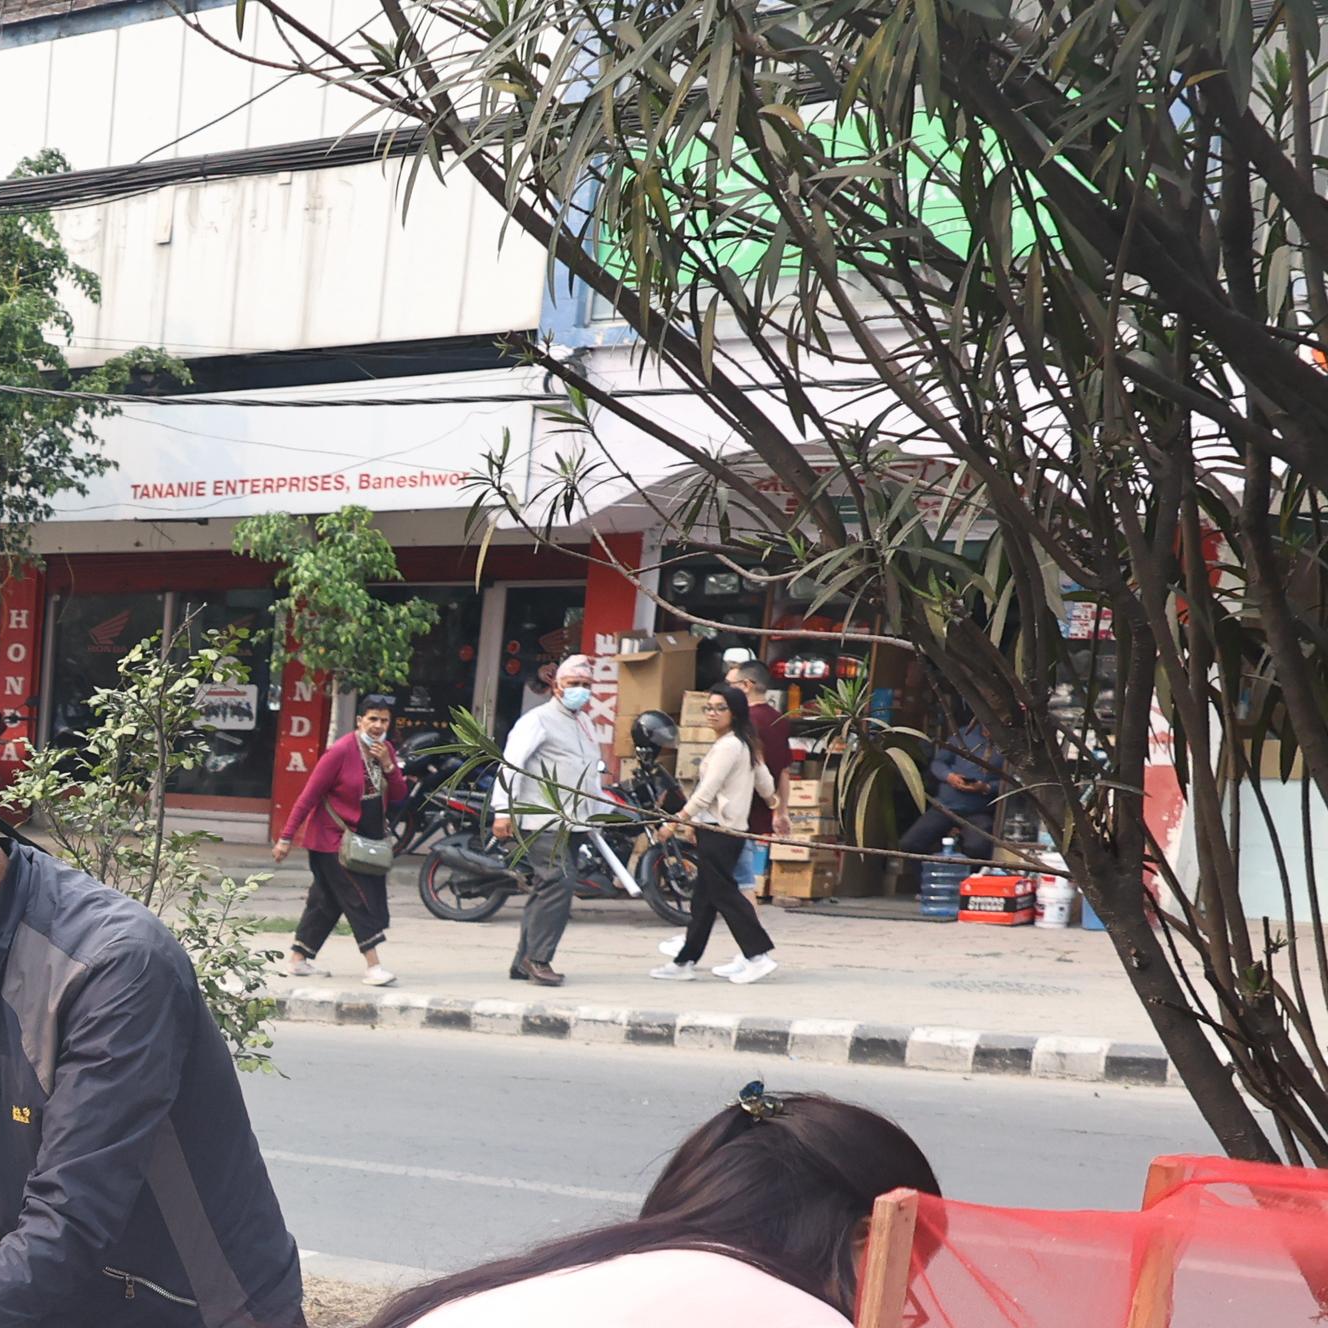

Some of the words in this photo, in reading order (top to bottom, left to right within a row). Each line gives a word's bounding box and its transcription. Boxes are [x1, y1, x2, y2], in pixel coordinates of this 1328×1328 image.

[131, 480, 205, 500] TANANIE
[213, 473, 351, 497] ENTERPRISES,
[359, 470, 470, 490] Baneshwor
[0, 609, 29, 761] HONDA
[590, 632, 619, 745] EXIDE
